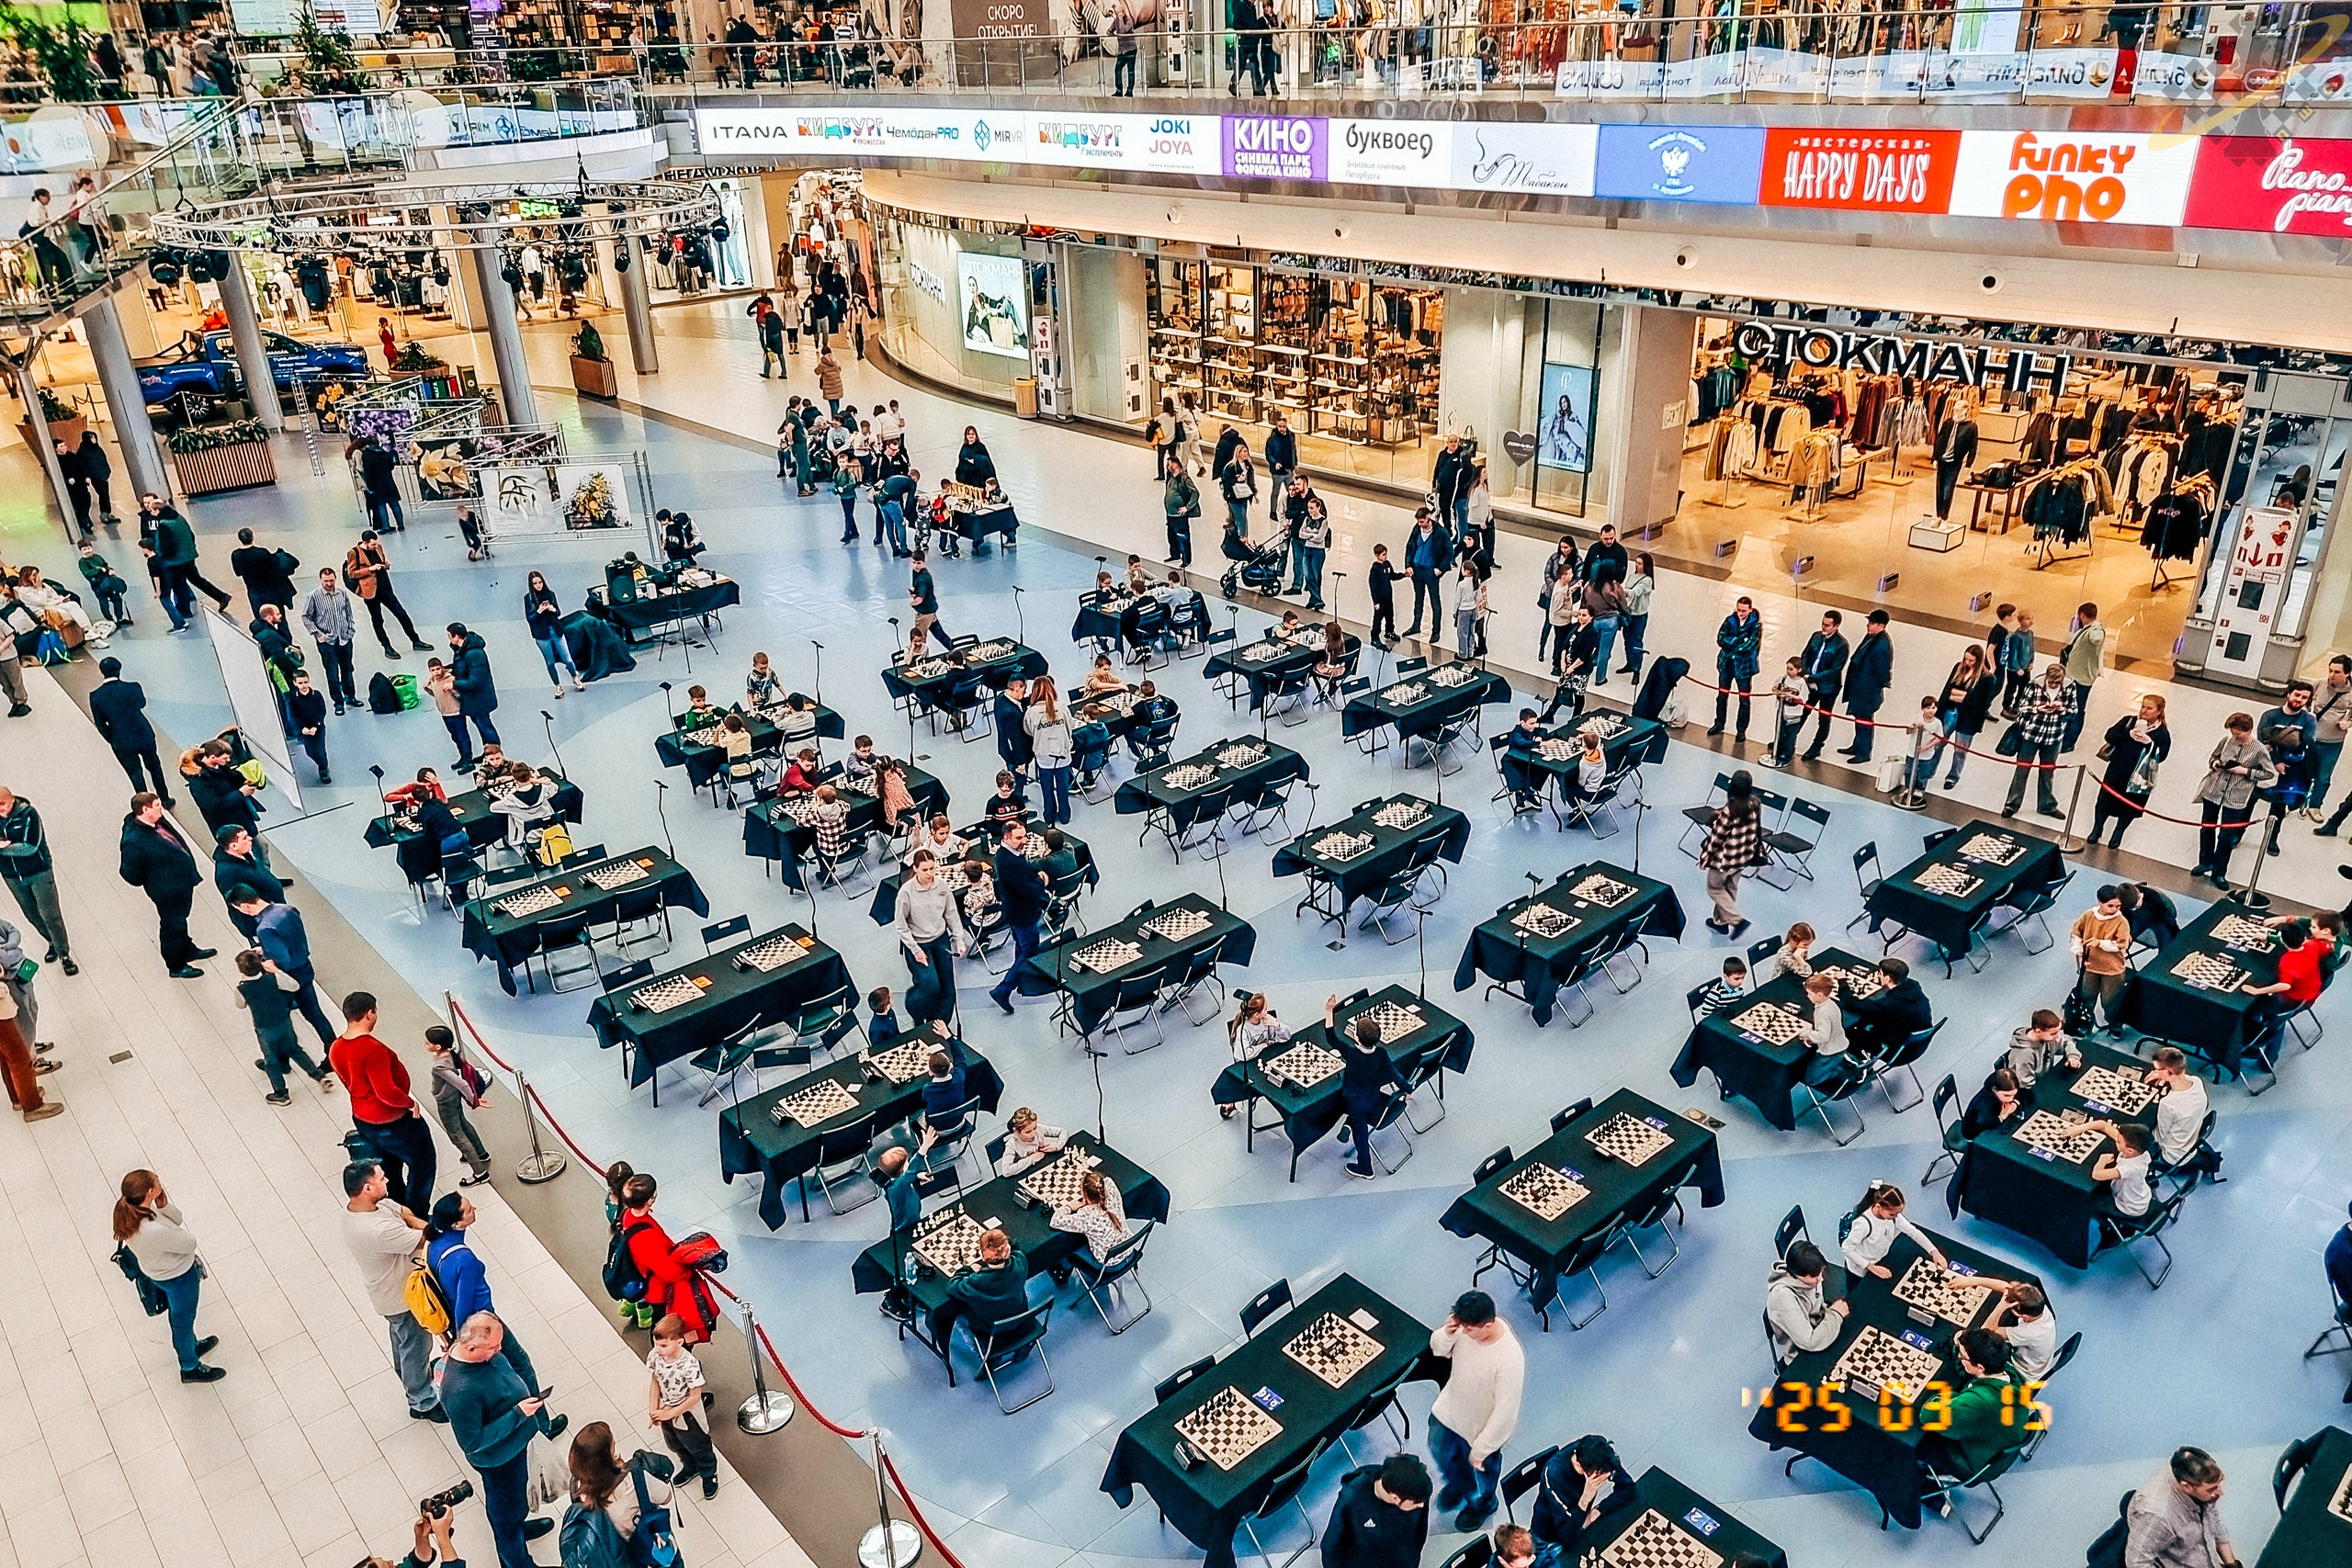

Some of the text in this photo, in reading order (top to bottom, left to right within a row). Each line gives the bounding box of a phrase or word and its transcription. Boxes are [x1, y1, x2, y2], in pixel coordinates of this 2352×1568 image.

[988, 5, 1024, 21] СКОРО
[978, 22, 1038, 38] ОТКРЫТИЕ!
[714, 126, 787, 139] ITANA
[797, 118, 883, 139] КИДБУРГ
[1038, 122, 1122, 148] КИДБУРГ
[1150, 119, 1190, 135] JOKI
[1234, 118, 1313, 153] КИНО
[1149, 140, 1193, 155] JOYA
[1799, 137, 1925, 151] мастерская
[1235, 153, 1311, 167] СИНЕМА ПАРК
[1235, 164, 1312, 178] ФОРМУЛА КИНО
[1783, 151, 1930, 203] HAPPY DAYS
[965, 260, 1023, 279] СТОКМАНН
[1733, 321, 2069, 397] СТОКМАНН
[1559, 1167, 1571, 1177] 14
[1951, 1262, 1962, 1271] 4
[1905, 1332, 1917, 1342] 3
[1257, 1386, 1269, 1402] 16
[1690, 1510, 1702, 1522] 2
